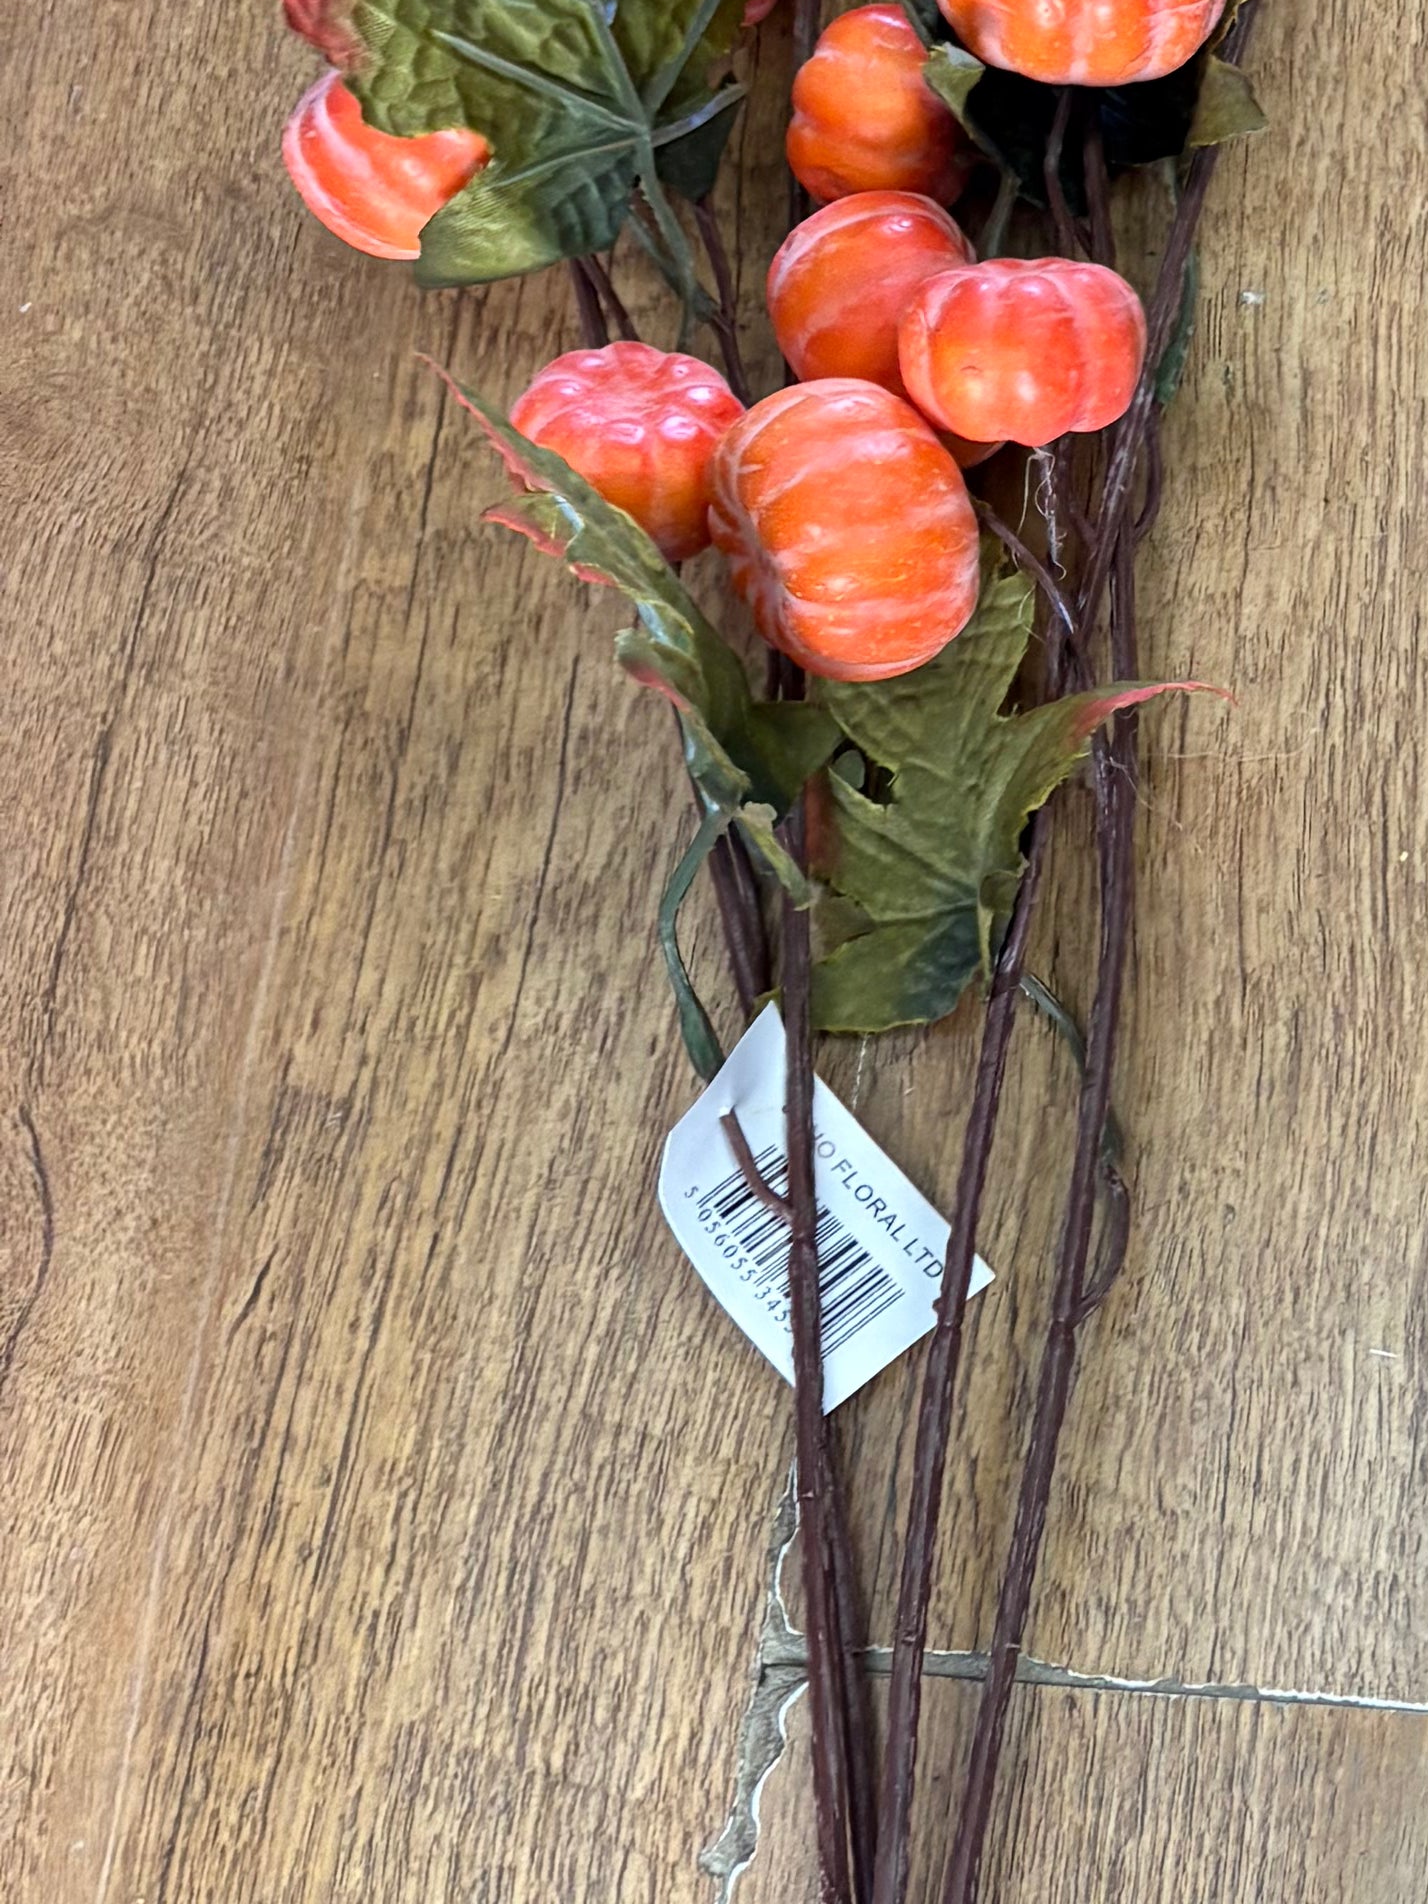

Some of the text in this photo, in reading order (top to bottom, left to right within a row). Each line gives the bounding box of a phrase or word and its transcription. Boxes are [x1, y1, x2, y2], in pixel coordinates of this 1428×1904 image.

[684, 1185, 699, 1198] 5
[697, 1209, 757, 1282] 056055
[831, 1158, 943, 1279] FLORAL LTD
